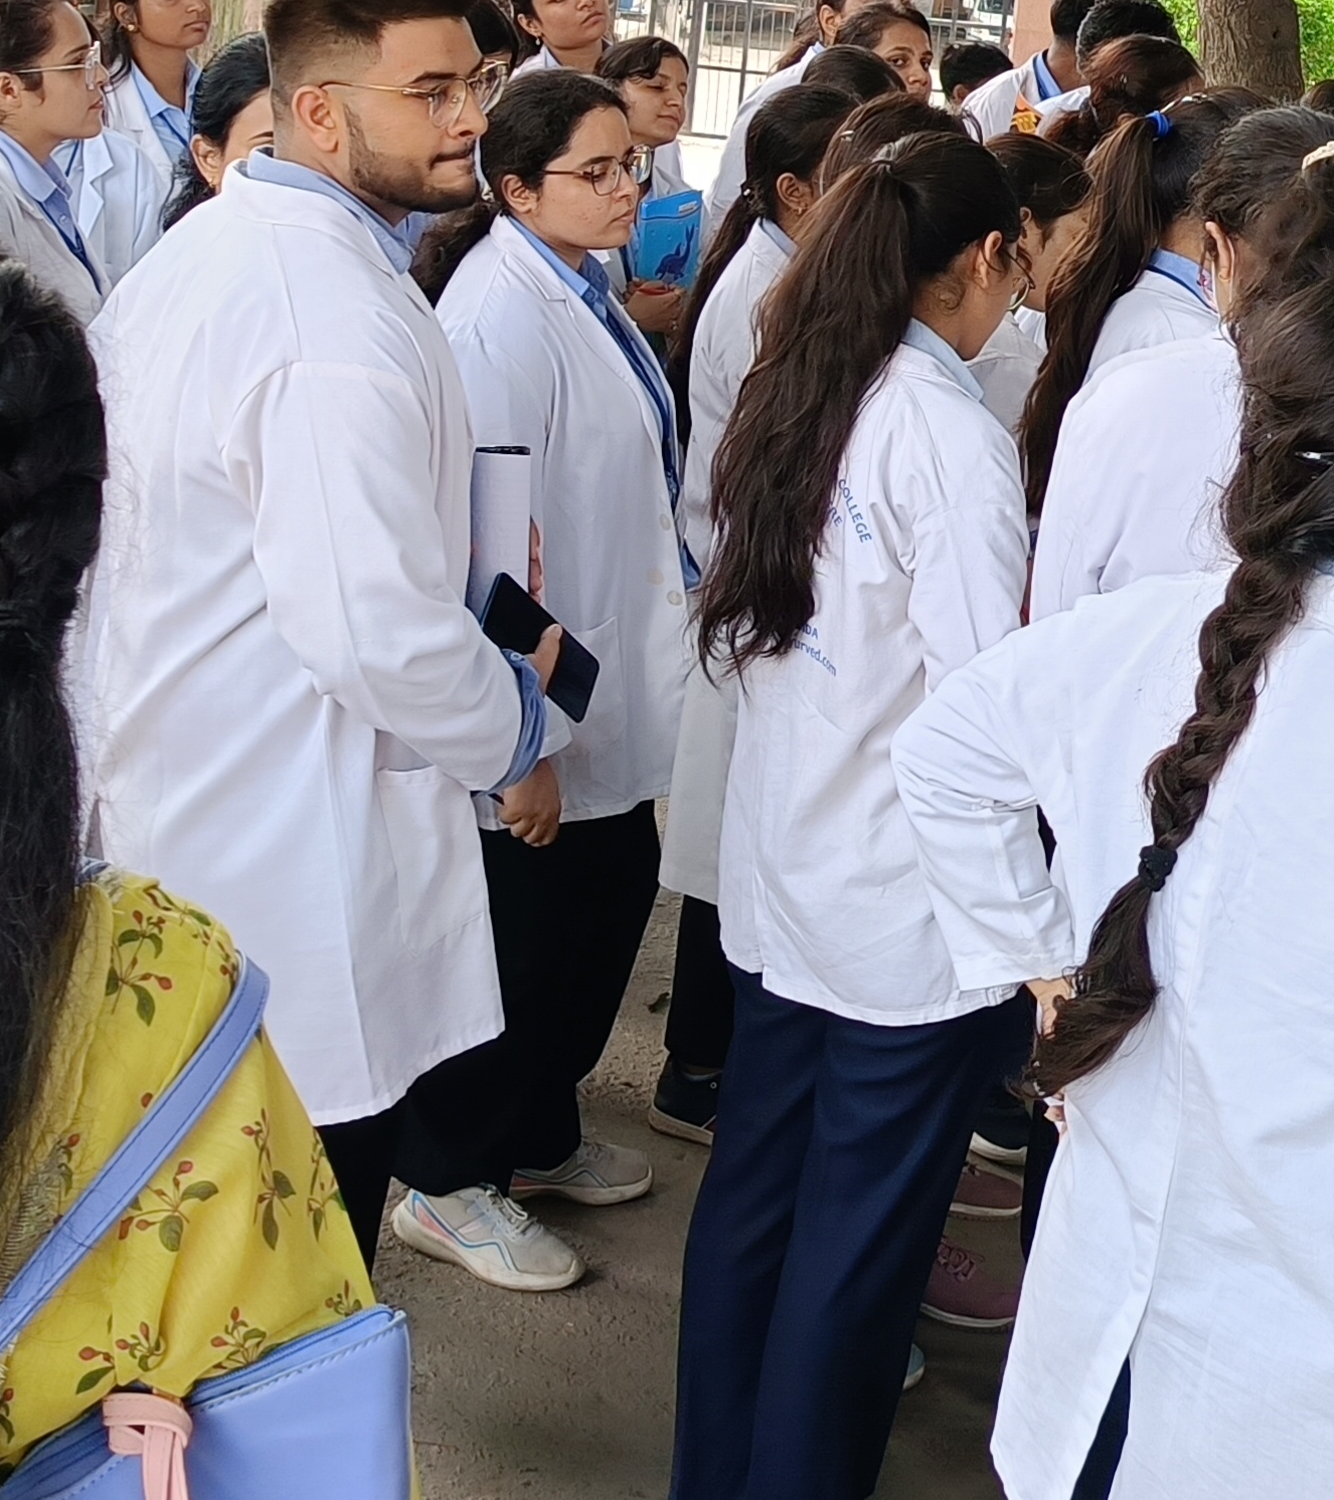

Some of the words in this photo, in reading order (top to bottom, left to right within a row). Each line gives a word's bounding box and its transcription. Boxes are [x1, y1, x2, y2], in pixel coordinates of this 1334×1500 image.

[838, 479, 872, 543] COLLEGE
[802, 622, 818, 640] IDA
[794, 639, 837, 677] urved.com
